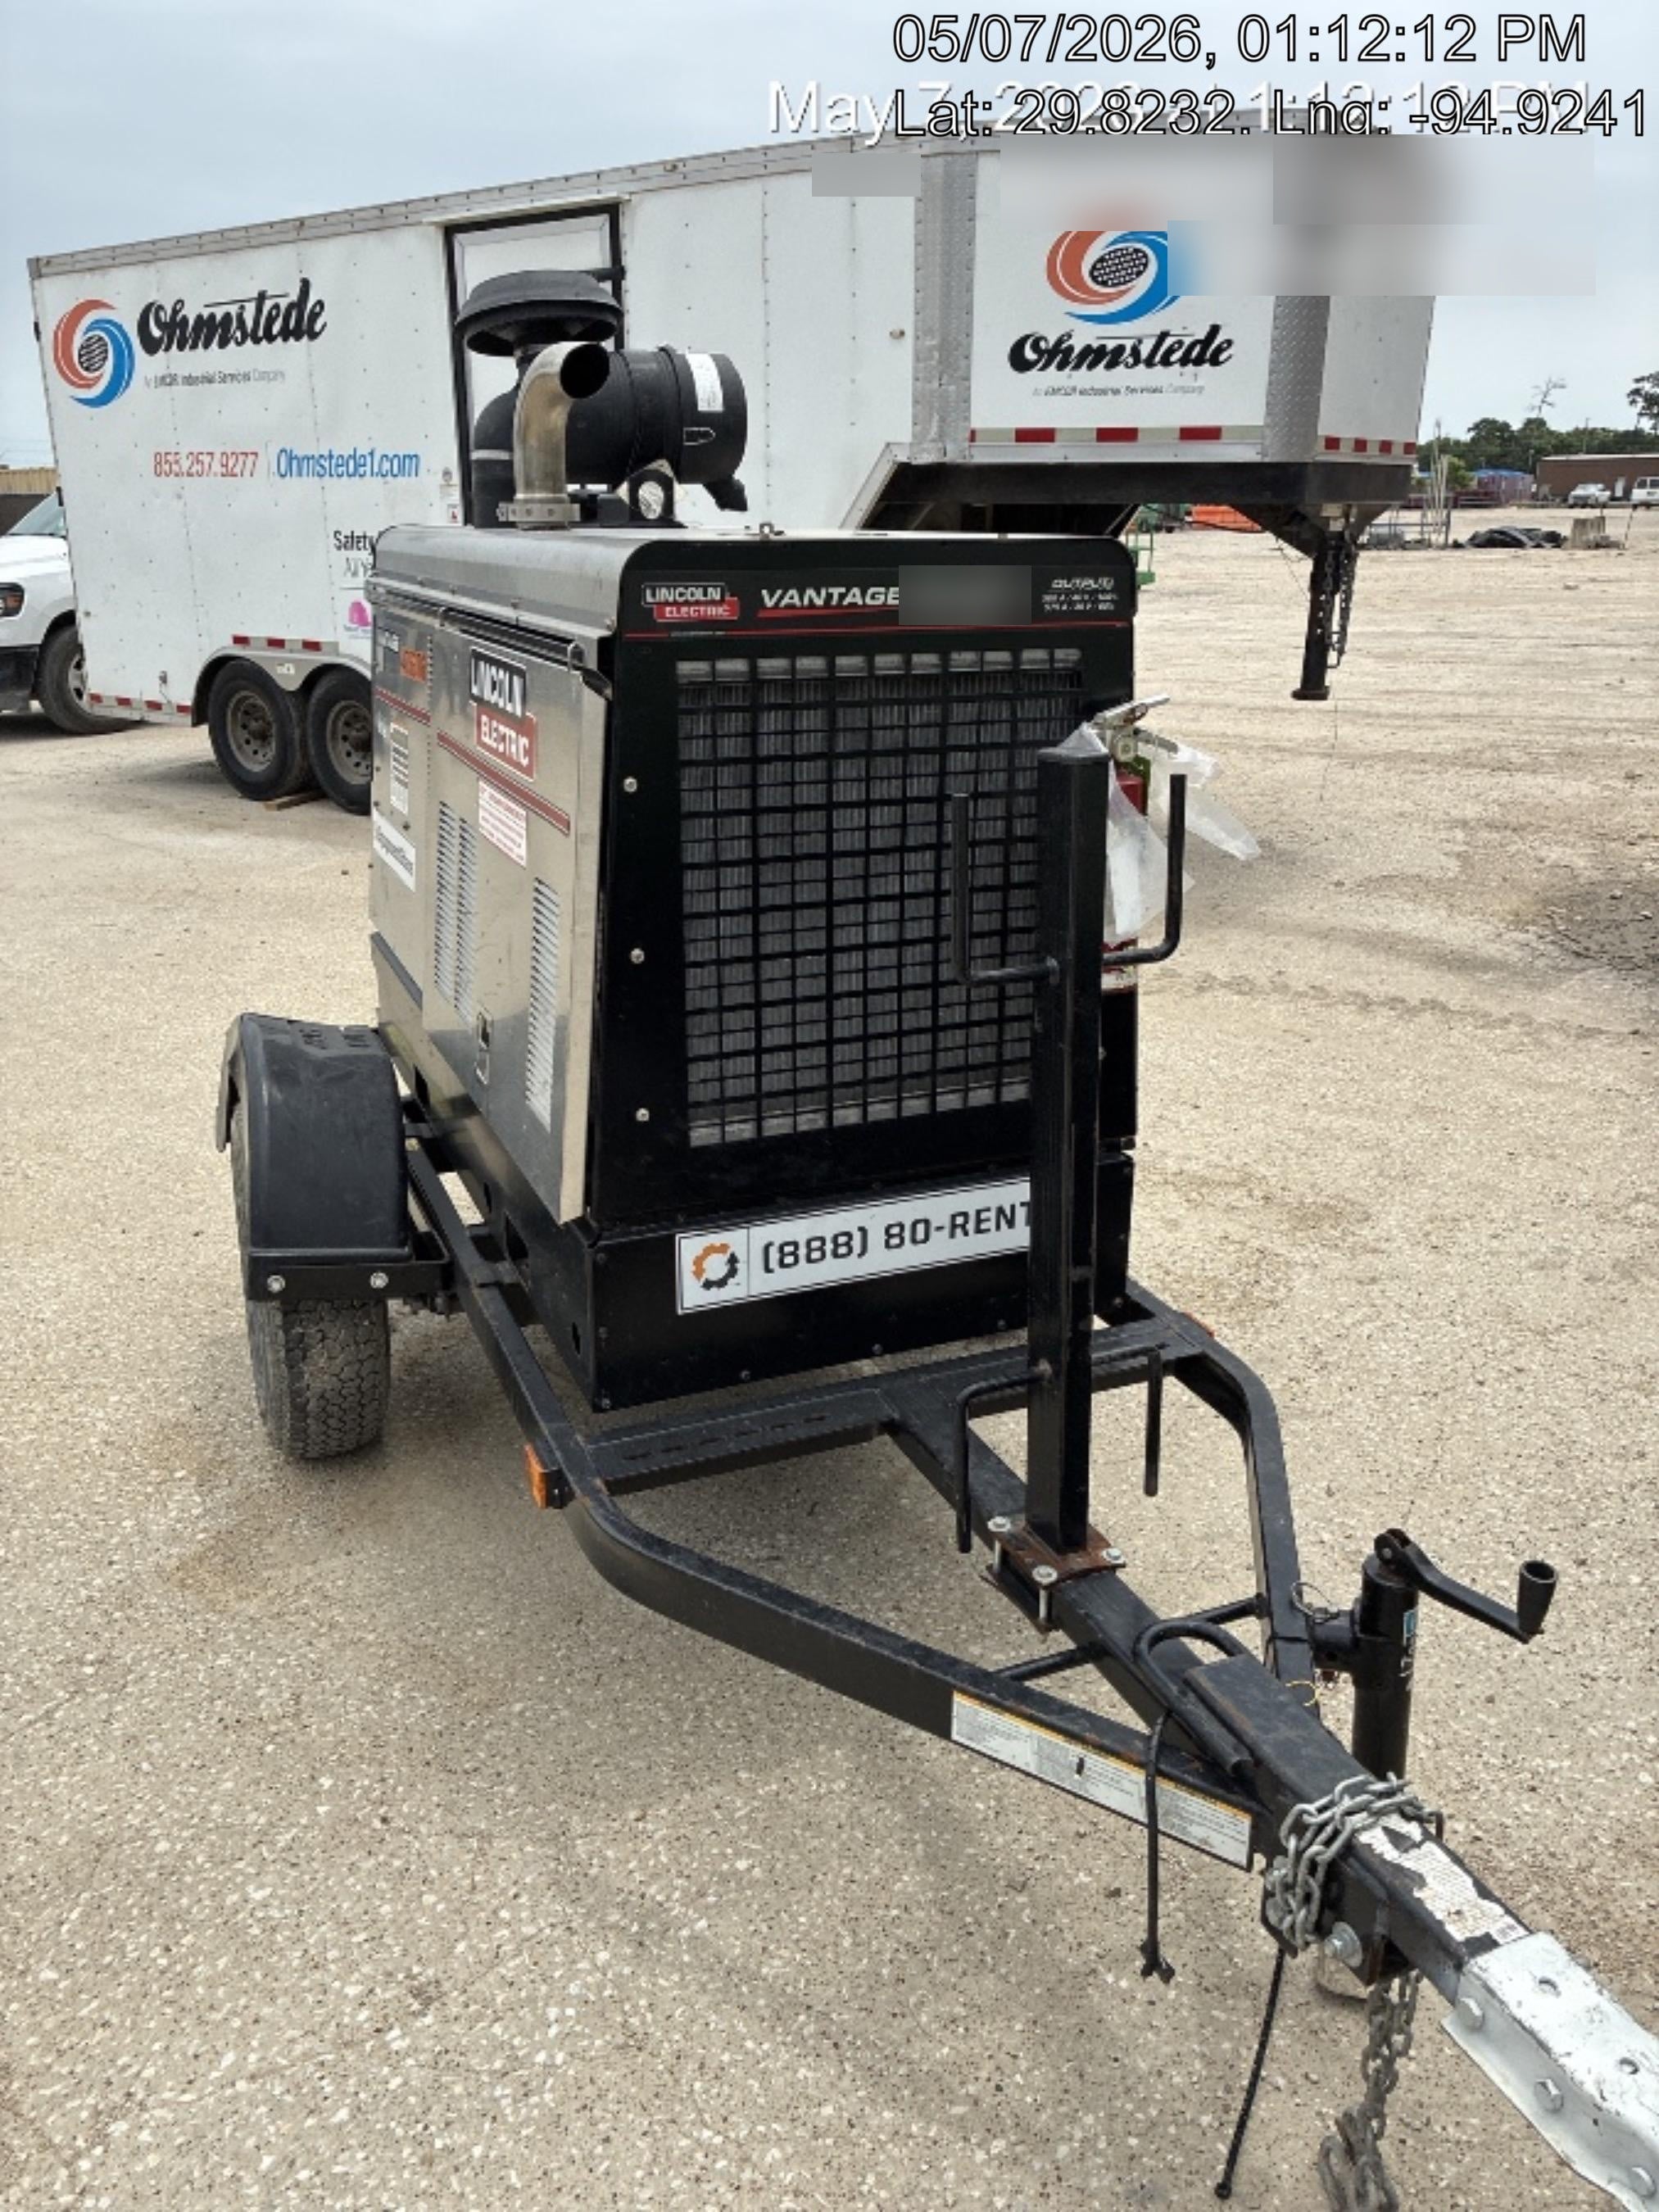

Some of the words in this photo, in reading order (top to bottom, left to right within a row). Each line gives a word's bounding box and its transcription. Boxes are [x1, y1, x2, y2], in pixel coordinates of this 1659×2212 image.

[138, 279, 328, 356] Ohmstede
[1009, 324, 1235, 374] Ohmstede
[153, 451, 259, 478] 855.257.9277
[276, 446, 420, 478] Ohmstede1.com
[645, 586, 722, 604] LINCOLN
[664, 605, 732, 618] ELECTRIC
[760, 586, 899, 608] VANTAGE
[471, 657, 525, 718] LINCOLN
[480, 714, 529, 768] ELECTRIC
[762, 1225, 868, 1274] (888)
